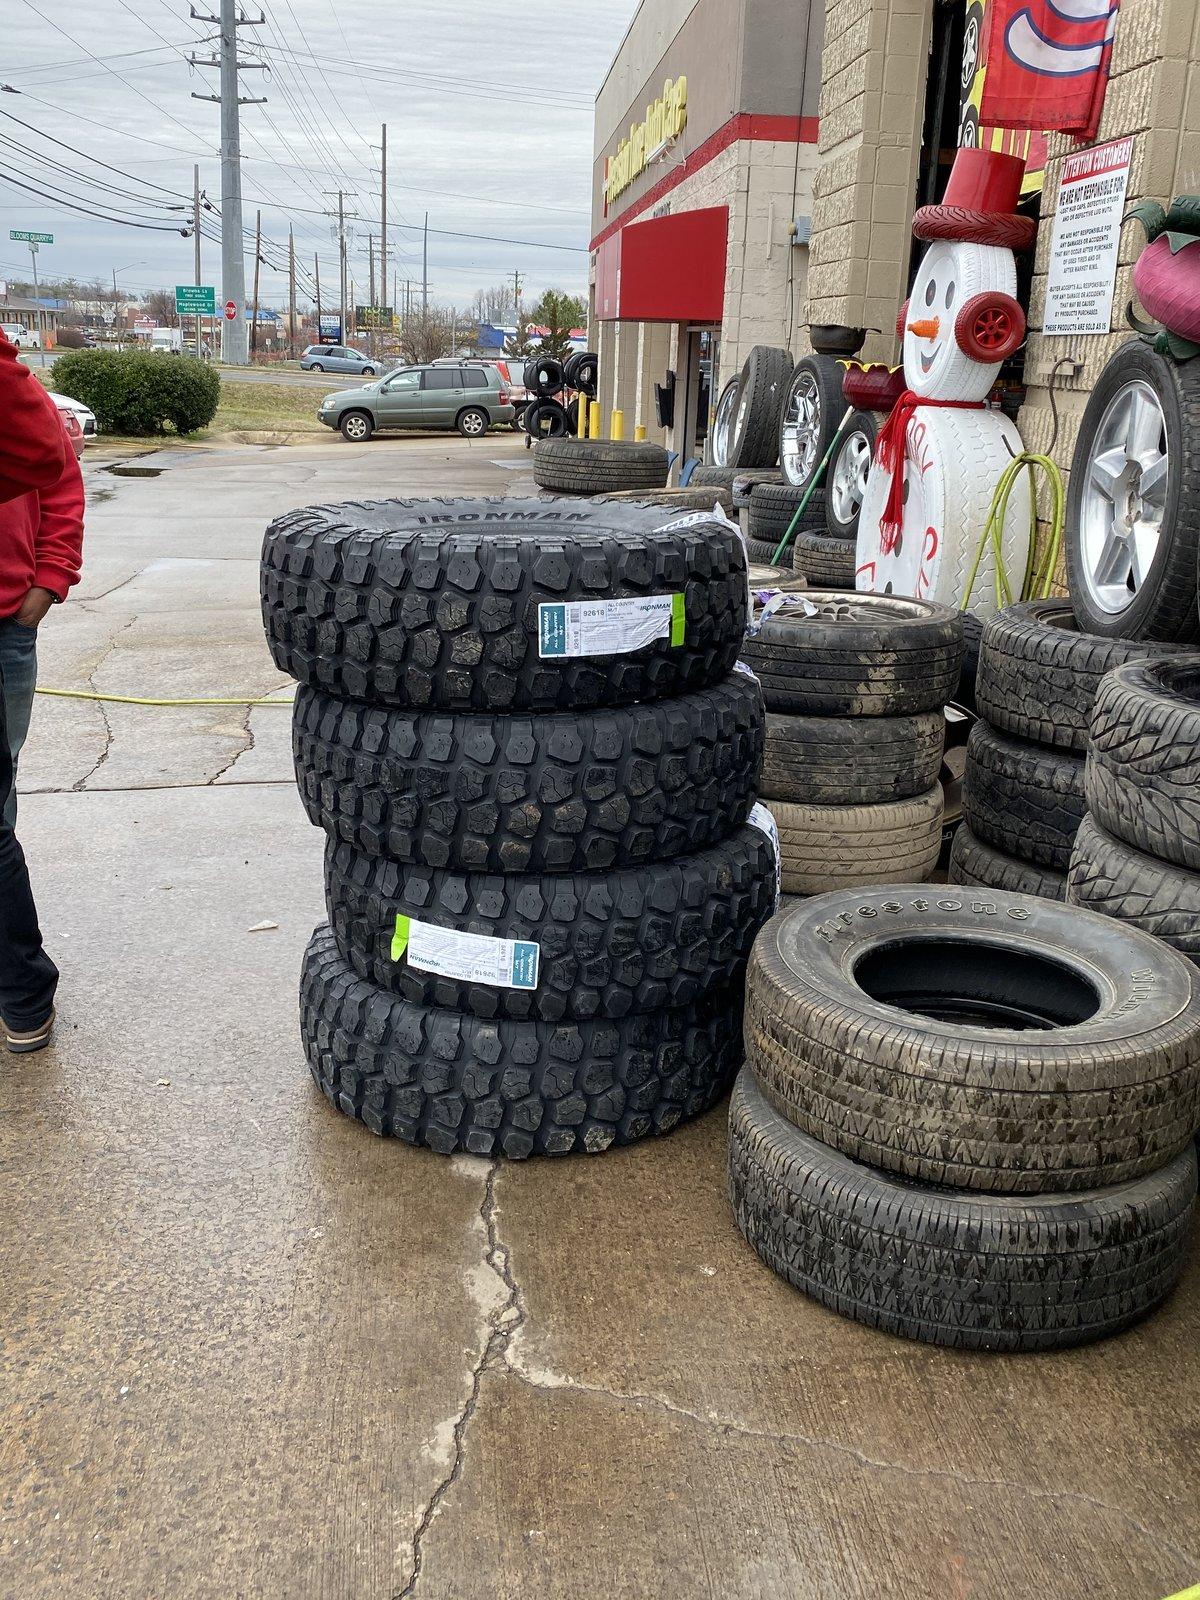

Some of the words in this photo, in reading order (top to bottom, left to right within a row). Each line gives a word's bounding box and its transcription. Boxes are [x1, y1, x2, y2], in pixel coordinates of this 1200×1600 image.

[1064, 152, 1094, 179] ATTENTION
[1093, 140, 1131, 172] CUSTOMERS
[1080, 226, 1104, 236] RESPONSIBLE
[224, 307, 236, 315] STOP
[1056, 324, 1077, 332] PRODUCTS
[418, 512, 594, 524] IRONMAN
[640, 602, 672, 612] IRONMAN
[583, 609, 605, 617] 92618
[410, 954, 441, 967] IRONMAN
